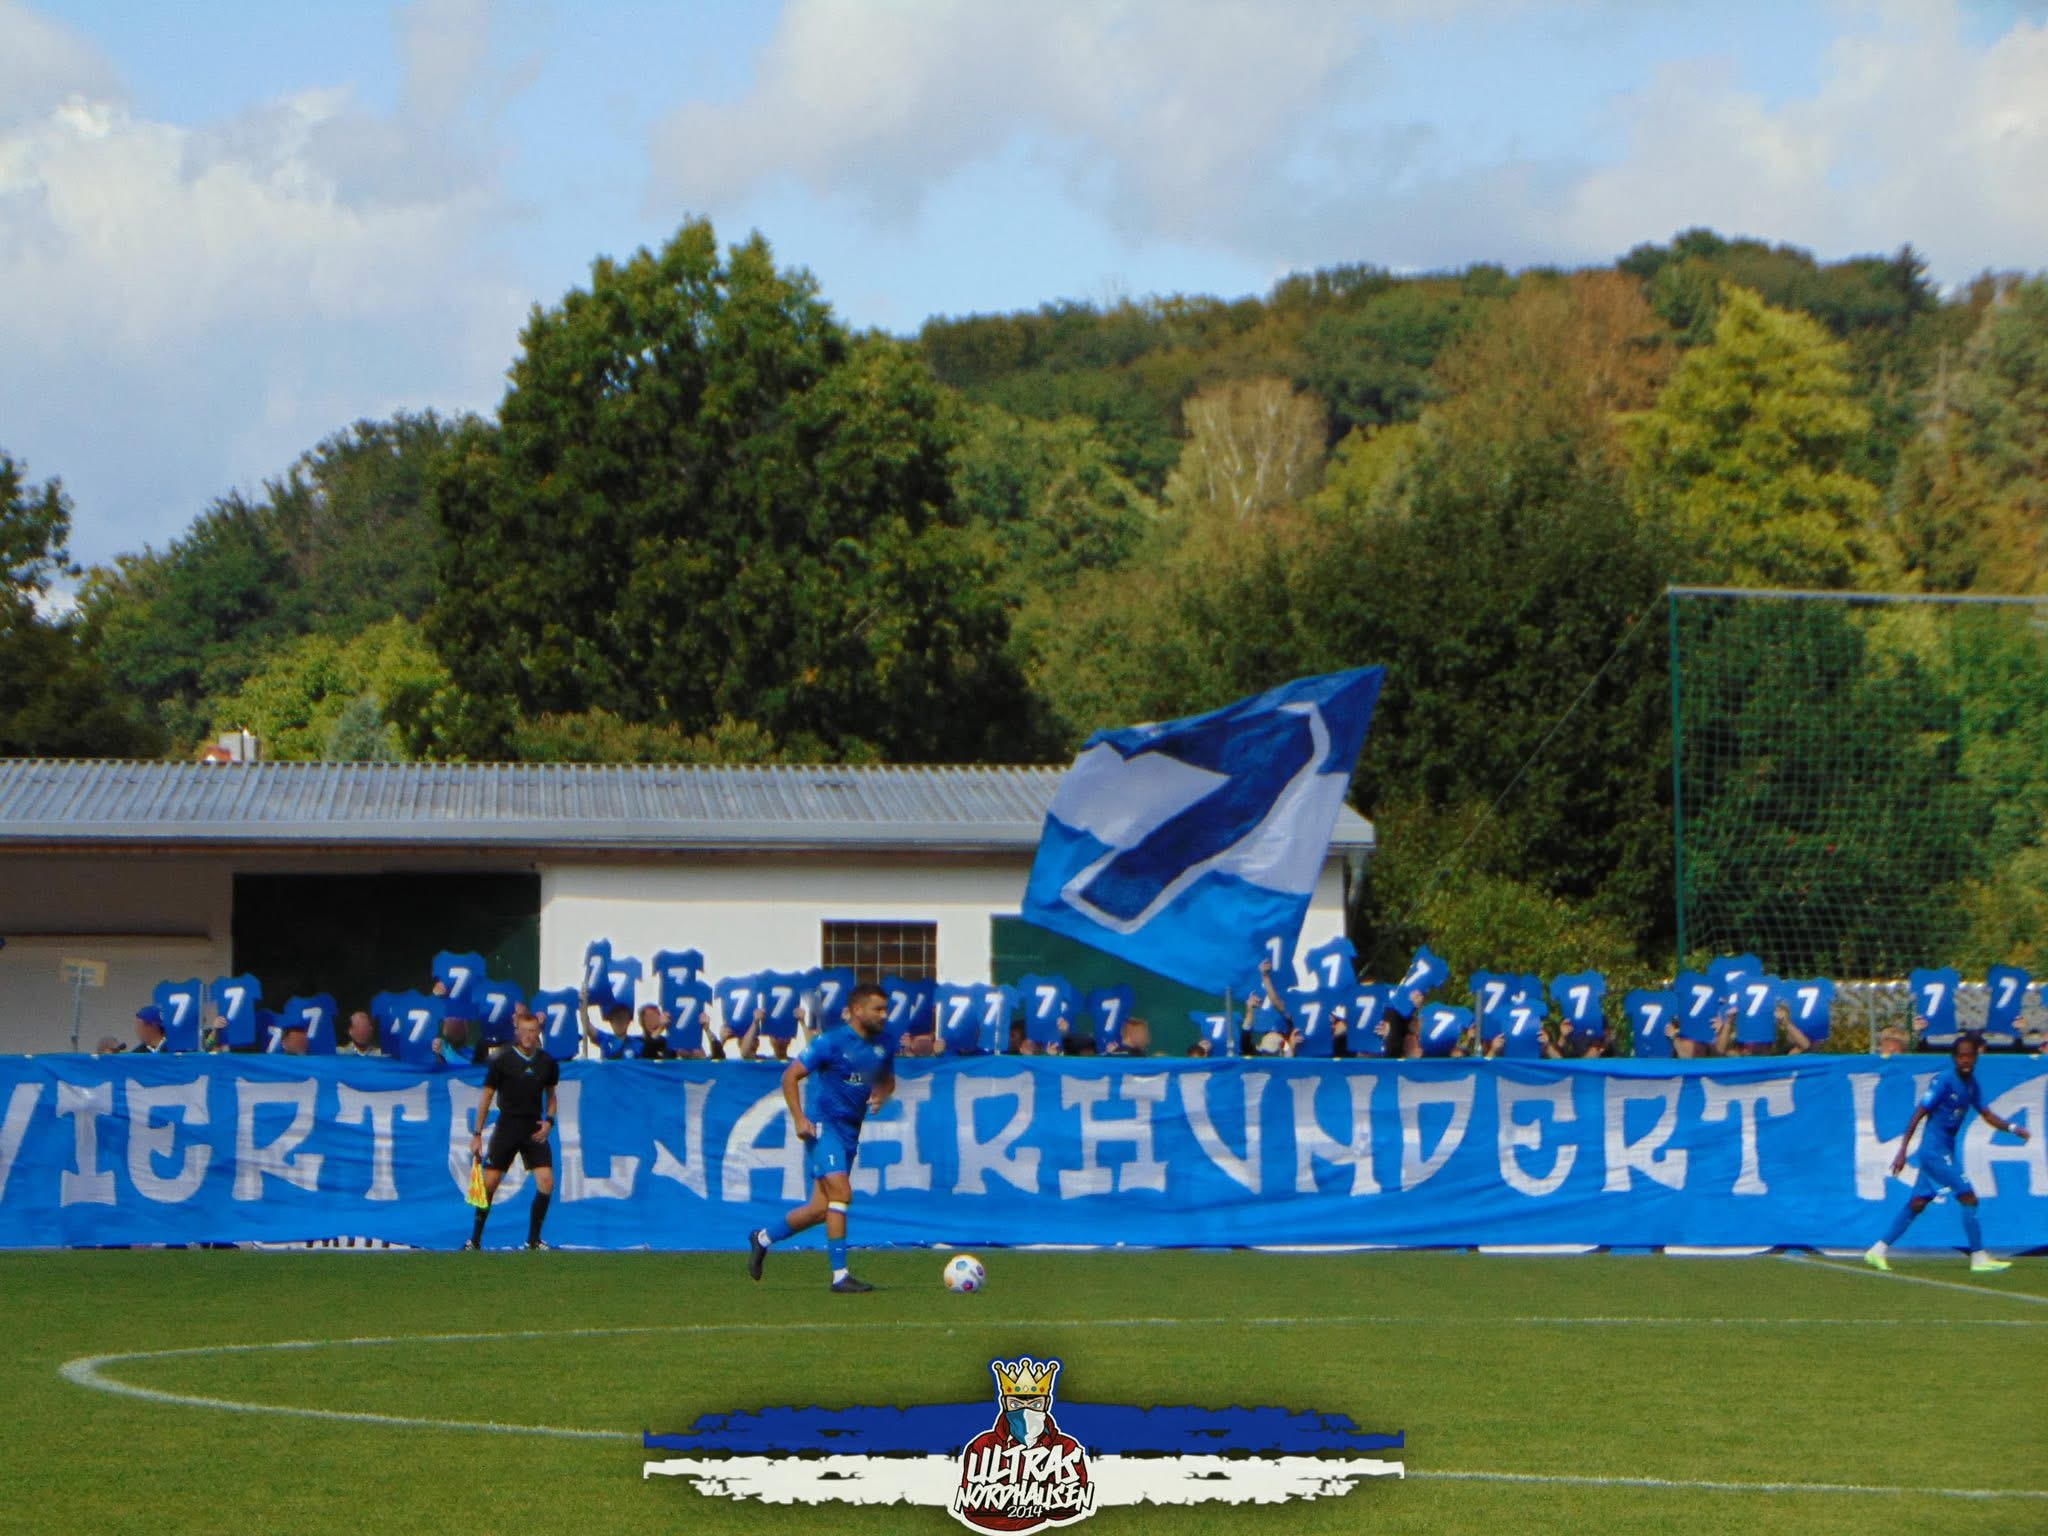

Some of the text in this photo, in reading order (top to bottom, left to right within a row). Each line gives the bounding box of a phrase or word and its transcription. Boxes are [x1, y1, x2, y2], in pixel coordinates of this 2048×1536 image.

[449, 967, 470, 998] 7
[607, 972, 628, 1001] 7
[820, 981, 840, 1010] 7
[1482, 981, 1507, 1013] 7
[1996, 977, 2018, 1008] 7
[168, 993, 191, 1024] 7
[224, 986, 246, 1020] 7
[487, 993, 507, 1022] 7
[676, 996, 696, 1029] 7
[729, 988, 751, 1020] 7
[771, 986, 793, 1018] 7
[888, 991, 907, 1022] 7
[947, 995, 971, 1028] 7
[984, 992, 1004, 1025] 7
[1035, 985, 1057, 1018] 7
[1102, 998, 1120, 1031] 7
[1356, 996, 1376, 1029] 7
[1568, 985, 1591, 1019] 7
[1690, 985, 1714, 1017] 7
[1746, 985, 1769, 1017] 7
[1797, 987, 1820, 1018] 7
[1923, 983, 1945, 1016] 7
[302, 1007, 322, 1038] 7
[408, 1009, 431, 1042] 7
[547, 1003, 567, 1036] 7
[1206, 1016, 1226, 1038] 7
[1300, 1002, 1321, 1035] 7
[1430, 1011, 1456, 1039] 7
[1509, 1008, 1531, 1035] 7
[1640, 1004, 1663, 1036] 7
